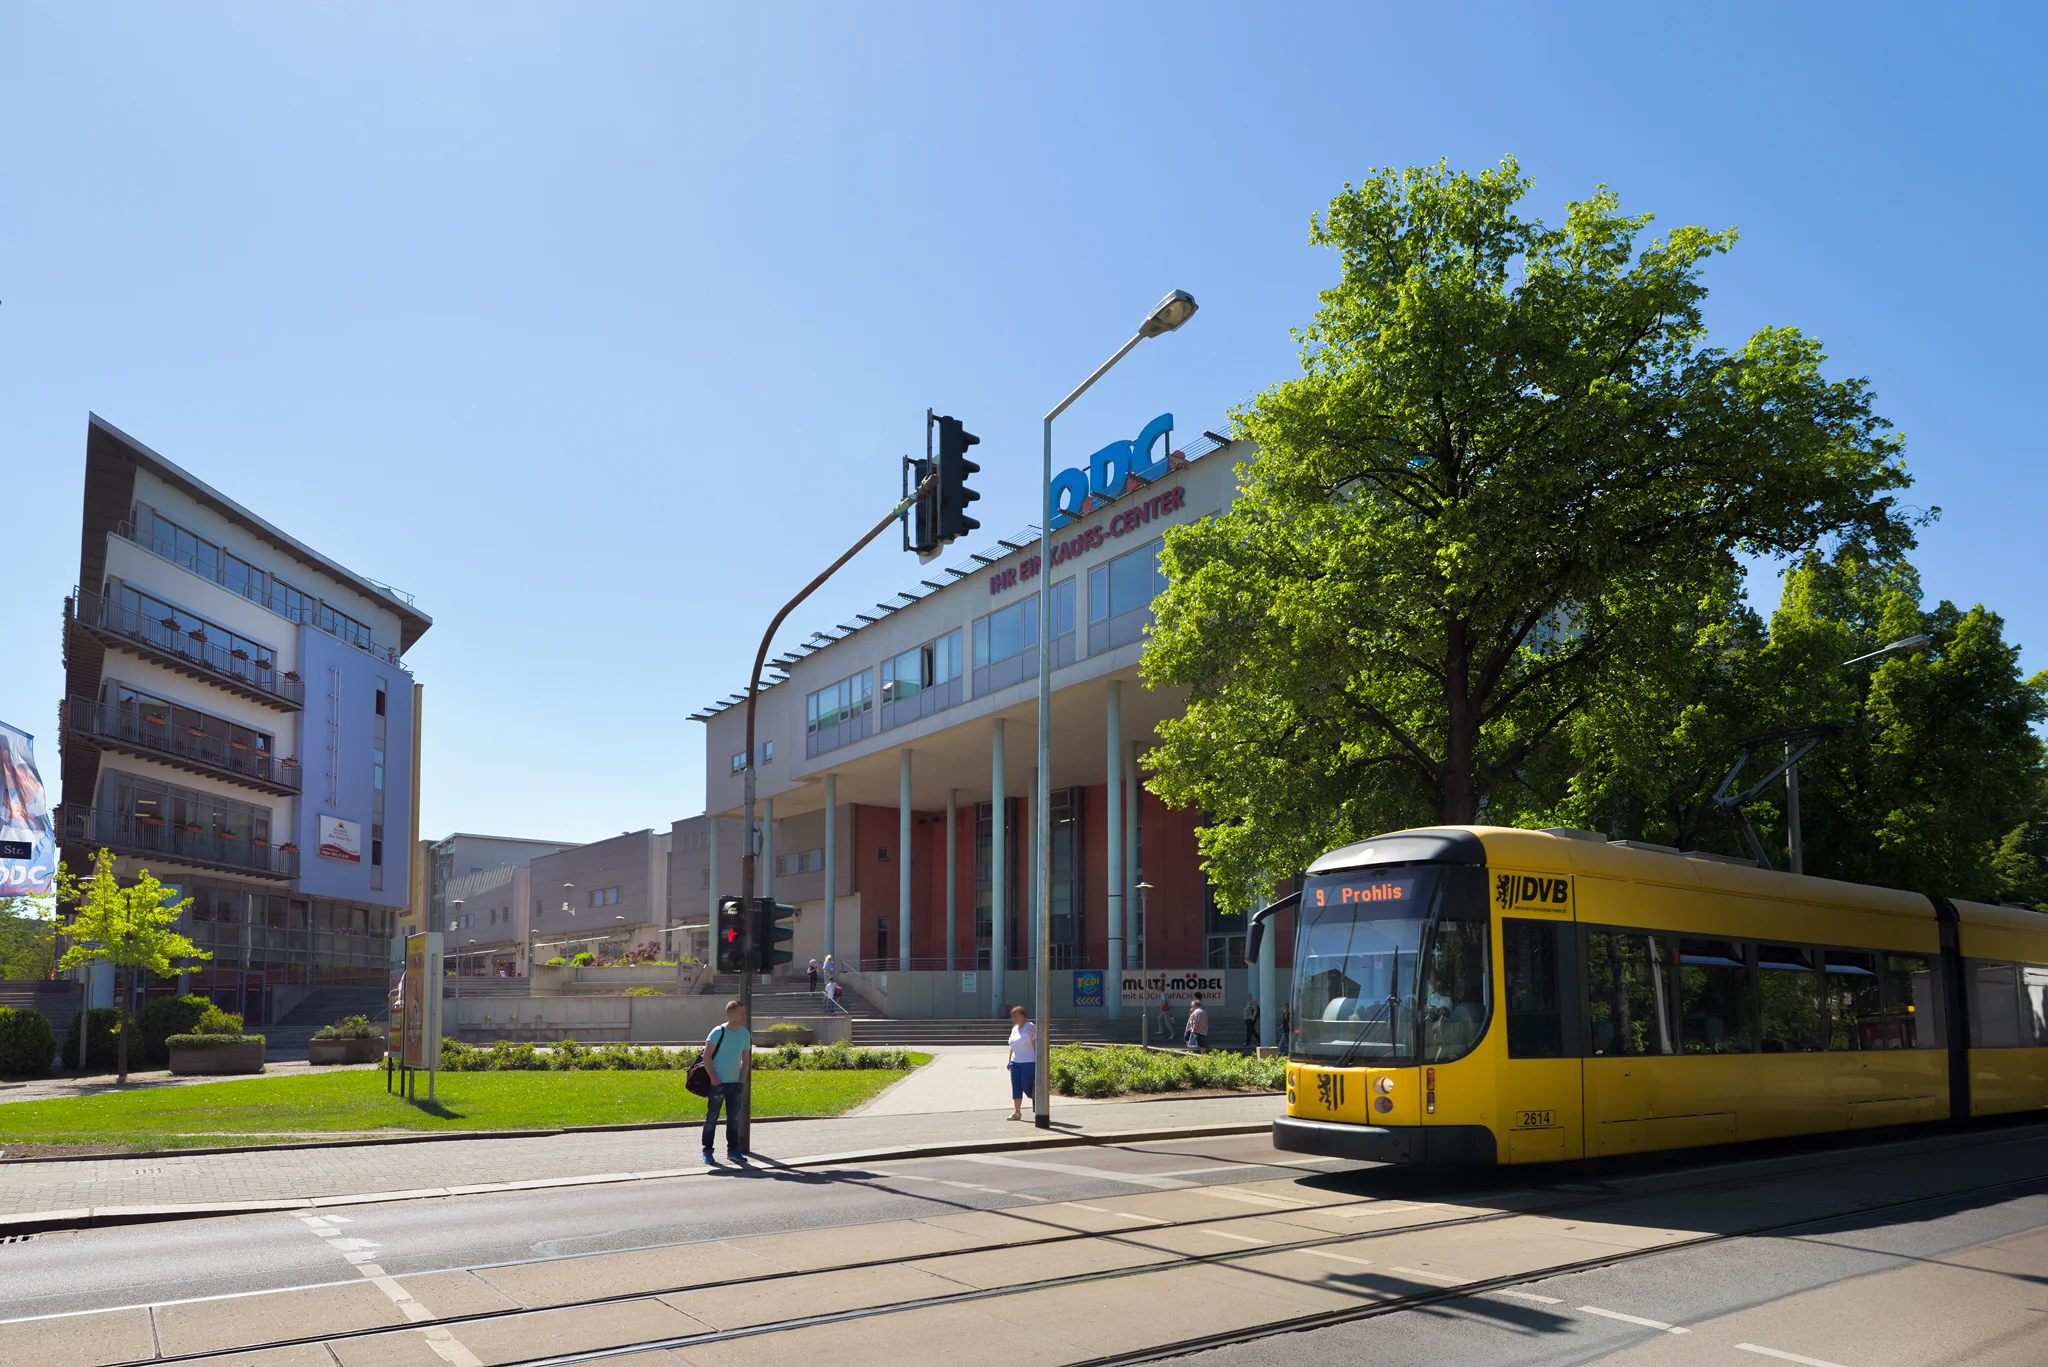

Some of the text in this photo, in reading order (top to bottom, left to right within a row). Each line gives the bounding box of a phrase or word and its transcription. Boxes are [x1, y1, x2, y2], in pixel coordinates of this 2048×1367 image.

[989, 486, 1186, 595] IHR EINKAUFS-CENTER
[4, 844, 24, 855] Str.
[1315, 883, 1403, 907] 9 Prohlis
[1521, 876, 1568, 904] DVB
[1123, 991, 1222, 1000] mit KÜCHNFACHARKT
[1523, 1111, 1551, 1125] 2614
